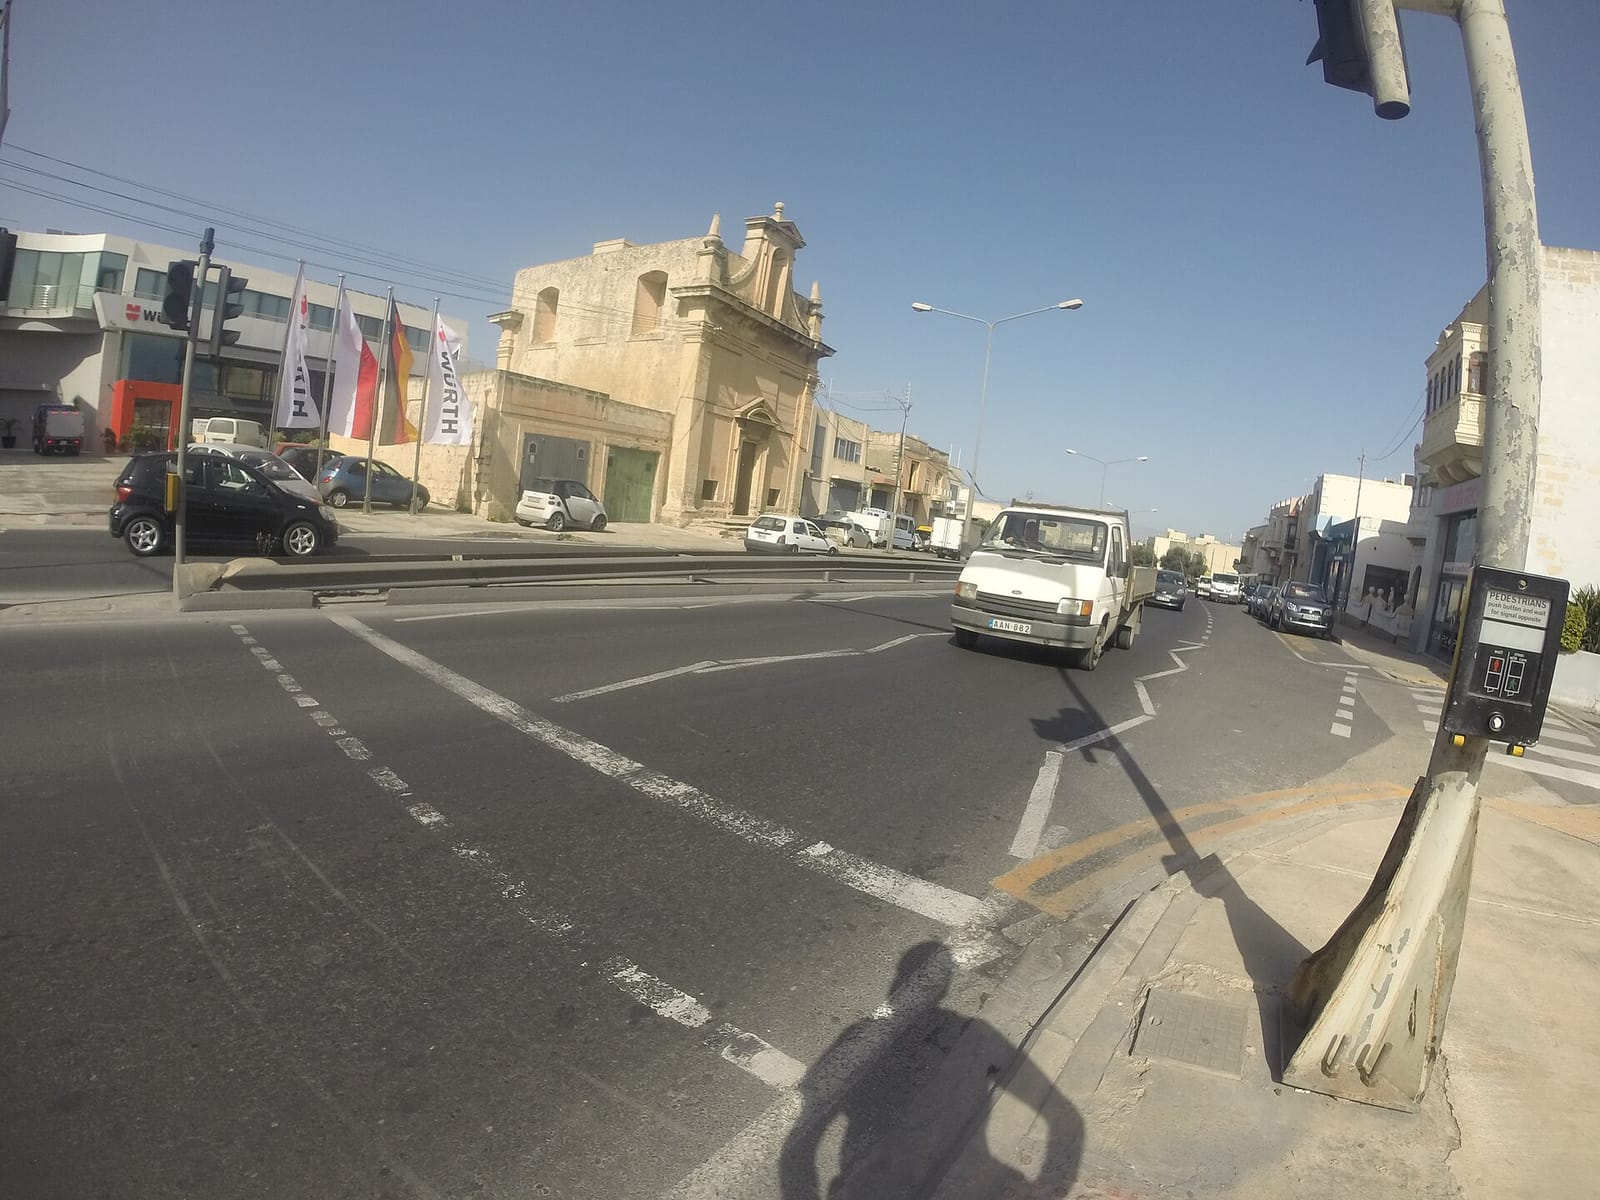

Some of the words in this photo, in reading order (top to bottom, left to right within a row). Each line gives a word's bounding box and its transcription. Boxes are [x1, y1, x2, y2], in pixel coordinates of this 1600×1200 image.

[1489, 592, 1547, 609] PEDESTRIANS
[1503, 604, 1521, 612] button
[1518, 614, 1541, 623] opposite
